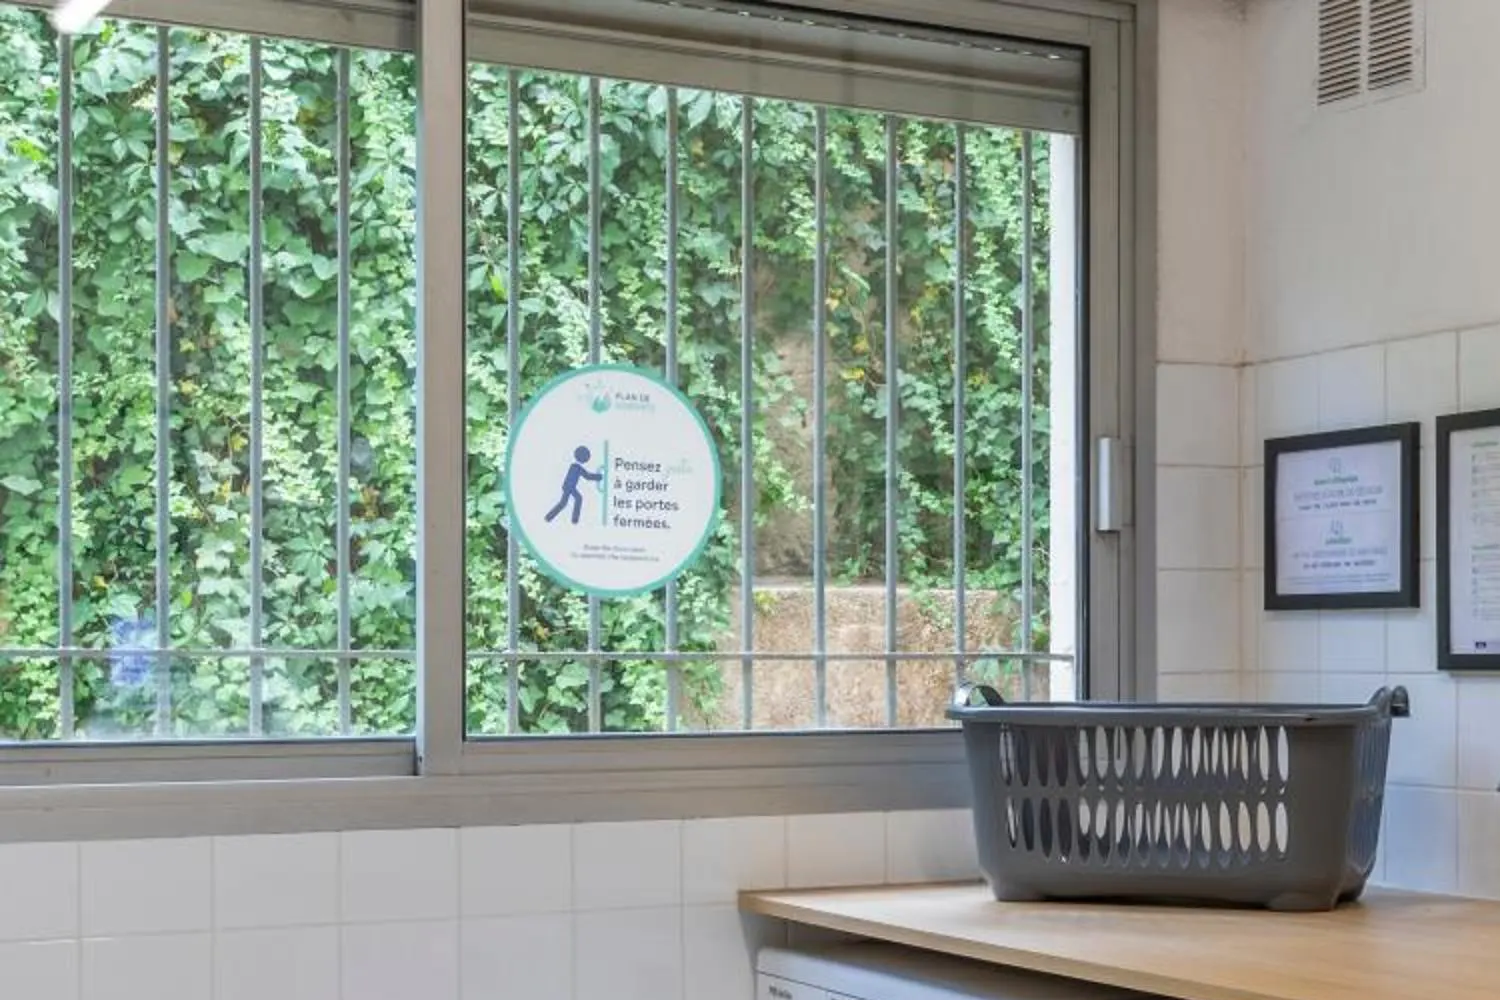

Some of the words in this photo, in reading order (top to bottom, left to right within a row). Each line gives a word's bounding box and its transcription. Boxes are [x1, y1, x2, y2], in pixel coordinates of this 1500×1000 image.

[615, 457, 661, 473] Pensez
[614, 476, 622, 489] à
[625, 479, 669, 493] garder
[613, 495, 633, 509] les
[636, 499, 679, 513] portes
[613, 514, 671, 530] fermées.
